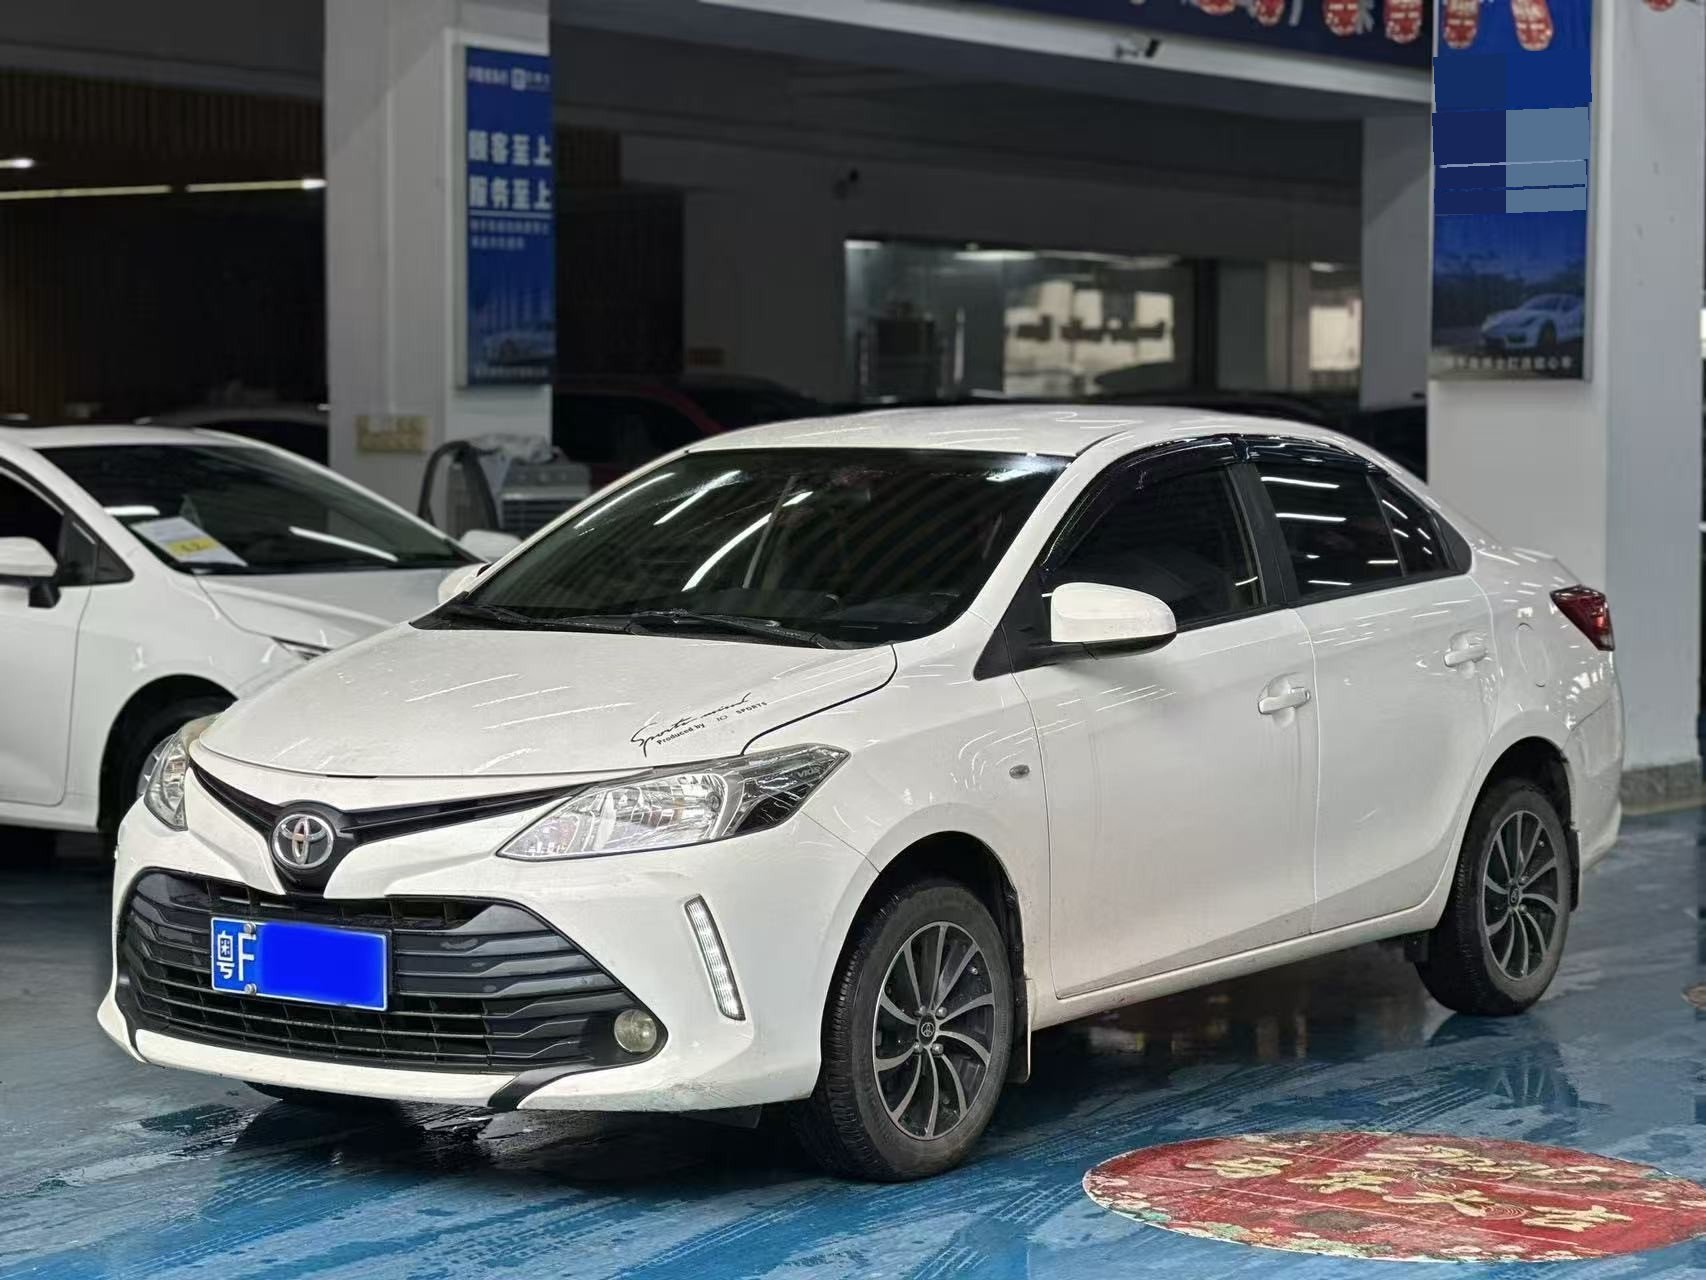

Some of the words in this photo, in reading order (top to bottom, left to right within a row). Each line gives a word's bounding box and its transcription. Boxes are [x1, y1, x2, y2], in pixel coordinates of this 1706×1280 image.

[468, 175, 552, 210] 服务至上
[656, 727, 694, 745] Produced
[694, 723, 705, 731] by
[735, 701, 768, 714] SPORTS
